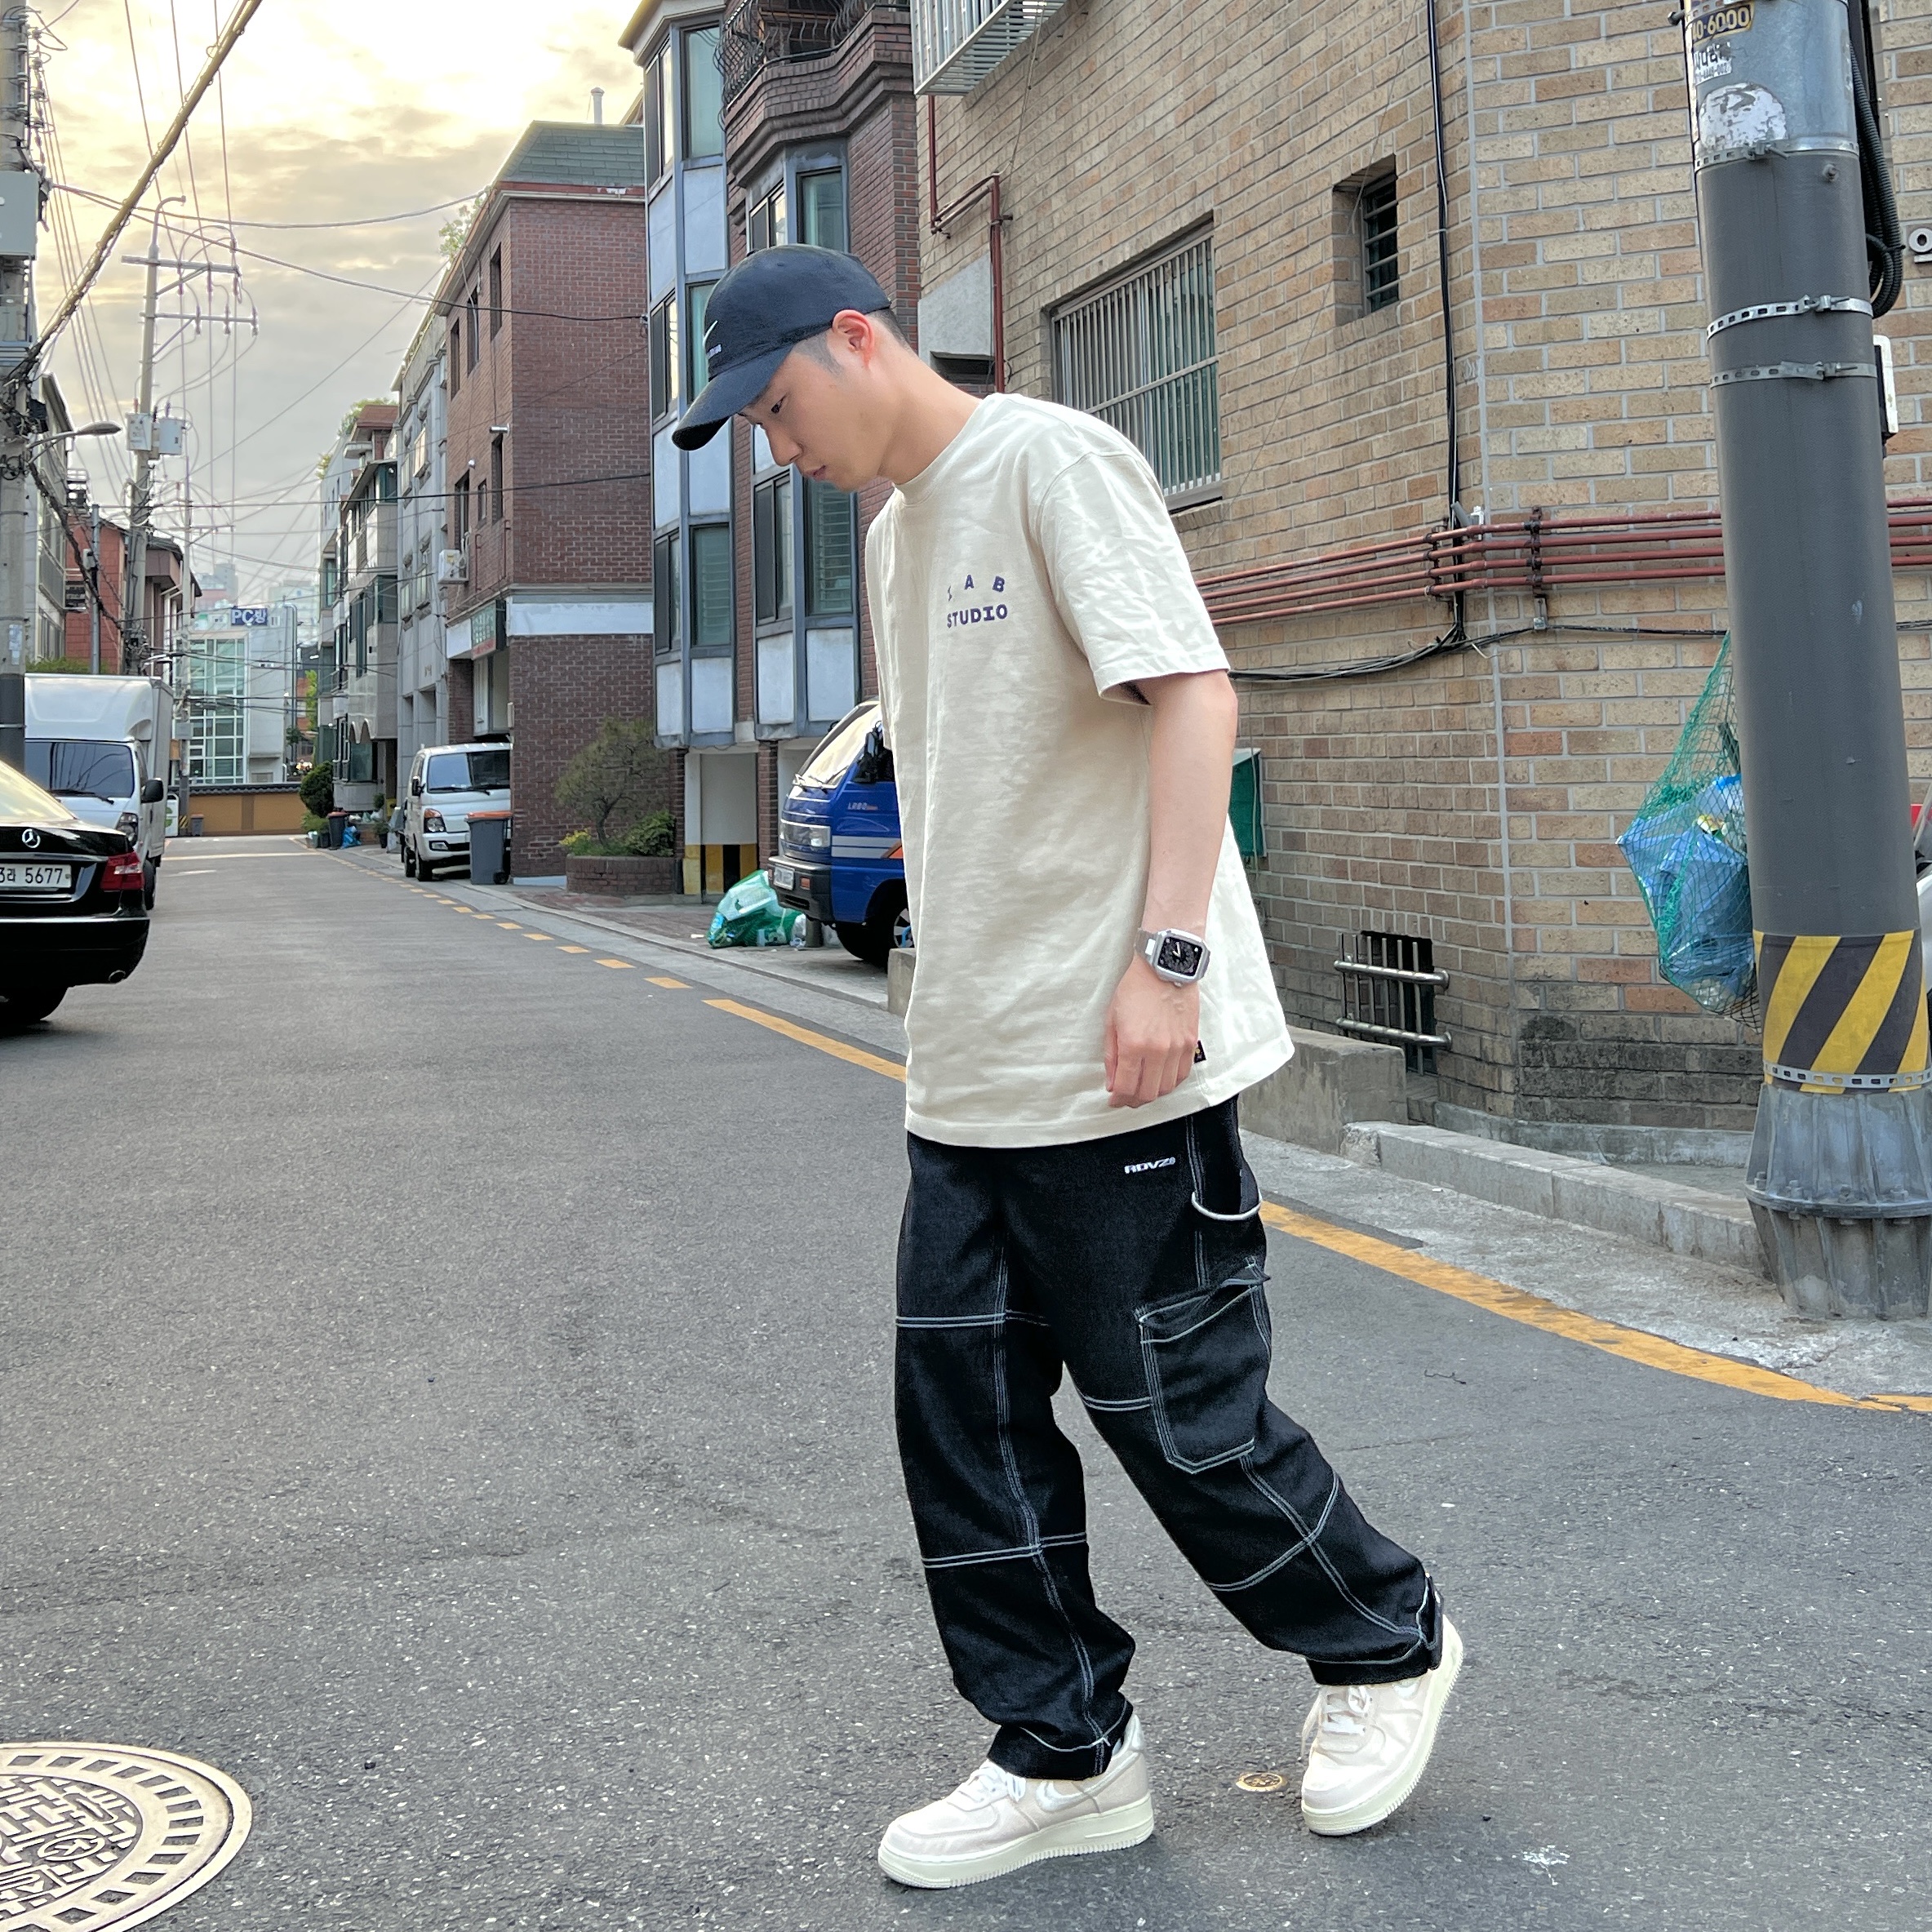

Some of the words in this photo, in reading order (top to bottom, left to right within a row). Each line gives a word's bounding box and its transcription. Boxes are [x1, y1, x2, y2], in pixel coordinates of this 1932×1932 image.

[232, 608, 267, 624] PC방
[947, 604, 1008, 628] STUDIO
[25, 867, 63, 884] 5677
